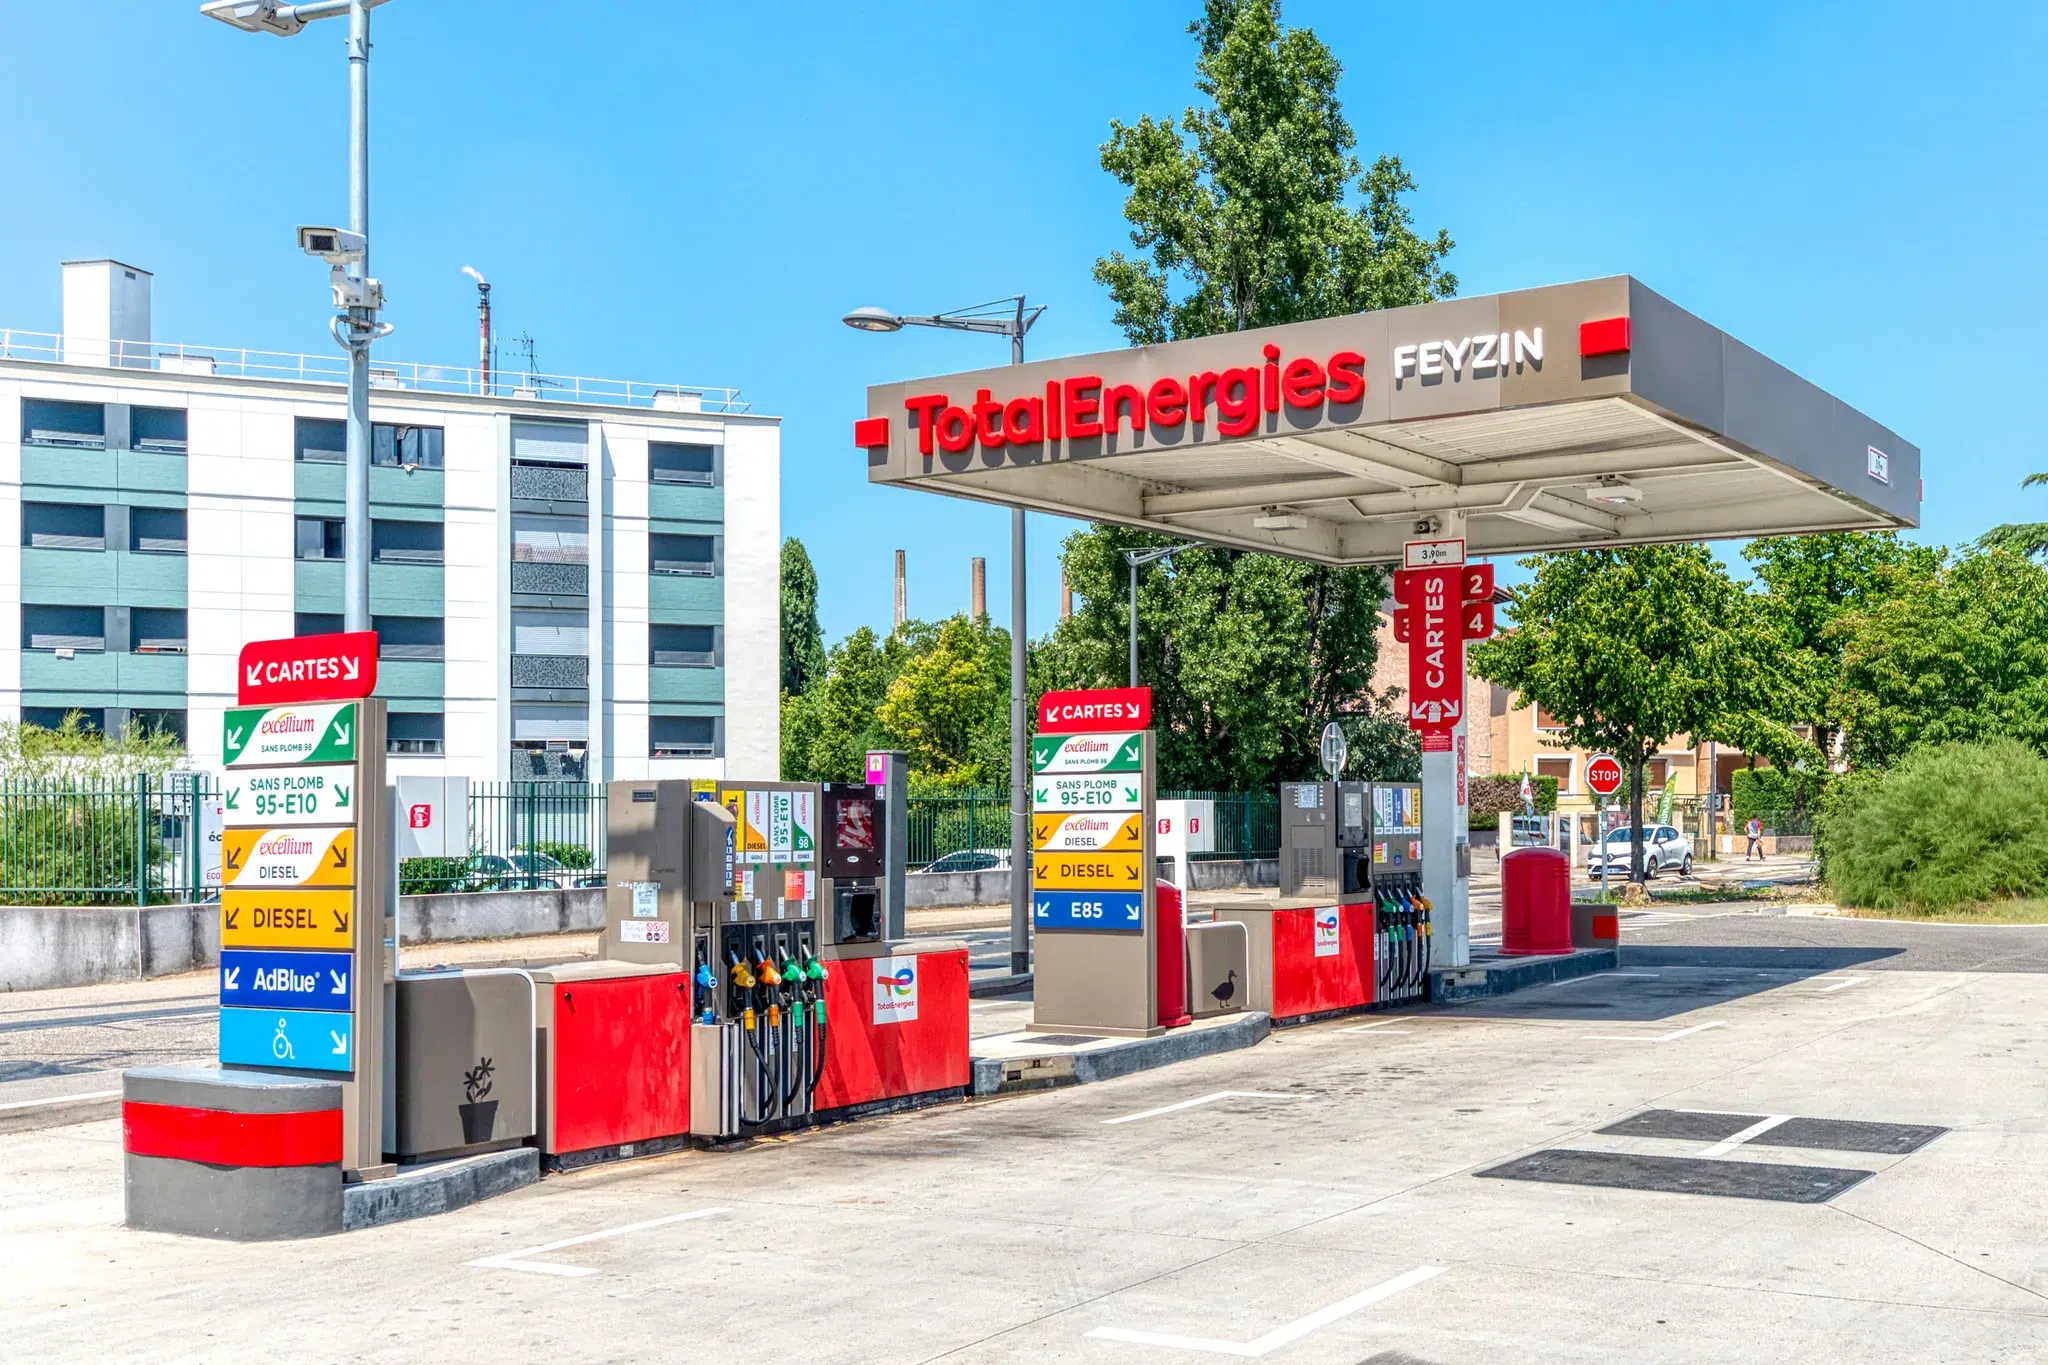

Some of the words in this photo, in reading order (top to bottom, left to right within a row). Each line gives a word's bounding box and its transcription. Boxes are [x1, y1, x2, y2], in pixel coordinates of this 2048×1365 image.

[1393, 327, 1544, 380] FEYZIN
[904, 343, 1366, 457] TotalEnergies
[1421, 549, 1447, 560] 3,90m
[1469, 574, 1484, 594] 2
[1468, 612, 1484, 632] 4
[1425, 577, 1445, 689] CARTES
[265, 655, 340, 684] CARTES
[1062, 703, 1123, 720] CARTES
[261, 712, 315, 735] excellium
[260, 745, 278, 753] SANS
[279, 744, 303, 752] PLOMB
[1064, 739, 1109, 753] excellium
[250, 778, 281, 791] SANS
[283, 776, 324, 790] PLOMB
[1591, 770, 1619, 782] STOP
[1056, 780, 1082, 790] SANS
[1083, 779, 1117, 789] PLOMB
[876, 786, 885, 800] 4
[1061, 791, 1112, 805] 95-E10
[255, 794, 317, 815] 95-E10
[752, 793, 760, 825] excellium
[780, 798, 789, 844] 95-E10
[1064, 817, 1109, 831] excellium
[260, 835, 313, 857] excellium
[747, 842, 766, 850] DIESEL
[798, 838, 809, 849] 98
[1064, 836, 1098, 846] DIESEL
[259, 865, 299, 880] DIESEL
[1061, 864, 1114, 878] DIESEL
[1071, 902, 1103, 919] E85
[253, 908, 318, 929] DIESEL
[876, 1000, 915, 1011] TotalEnergies
